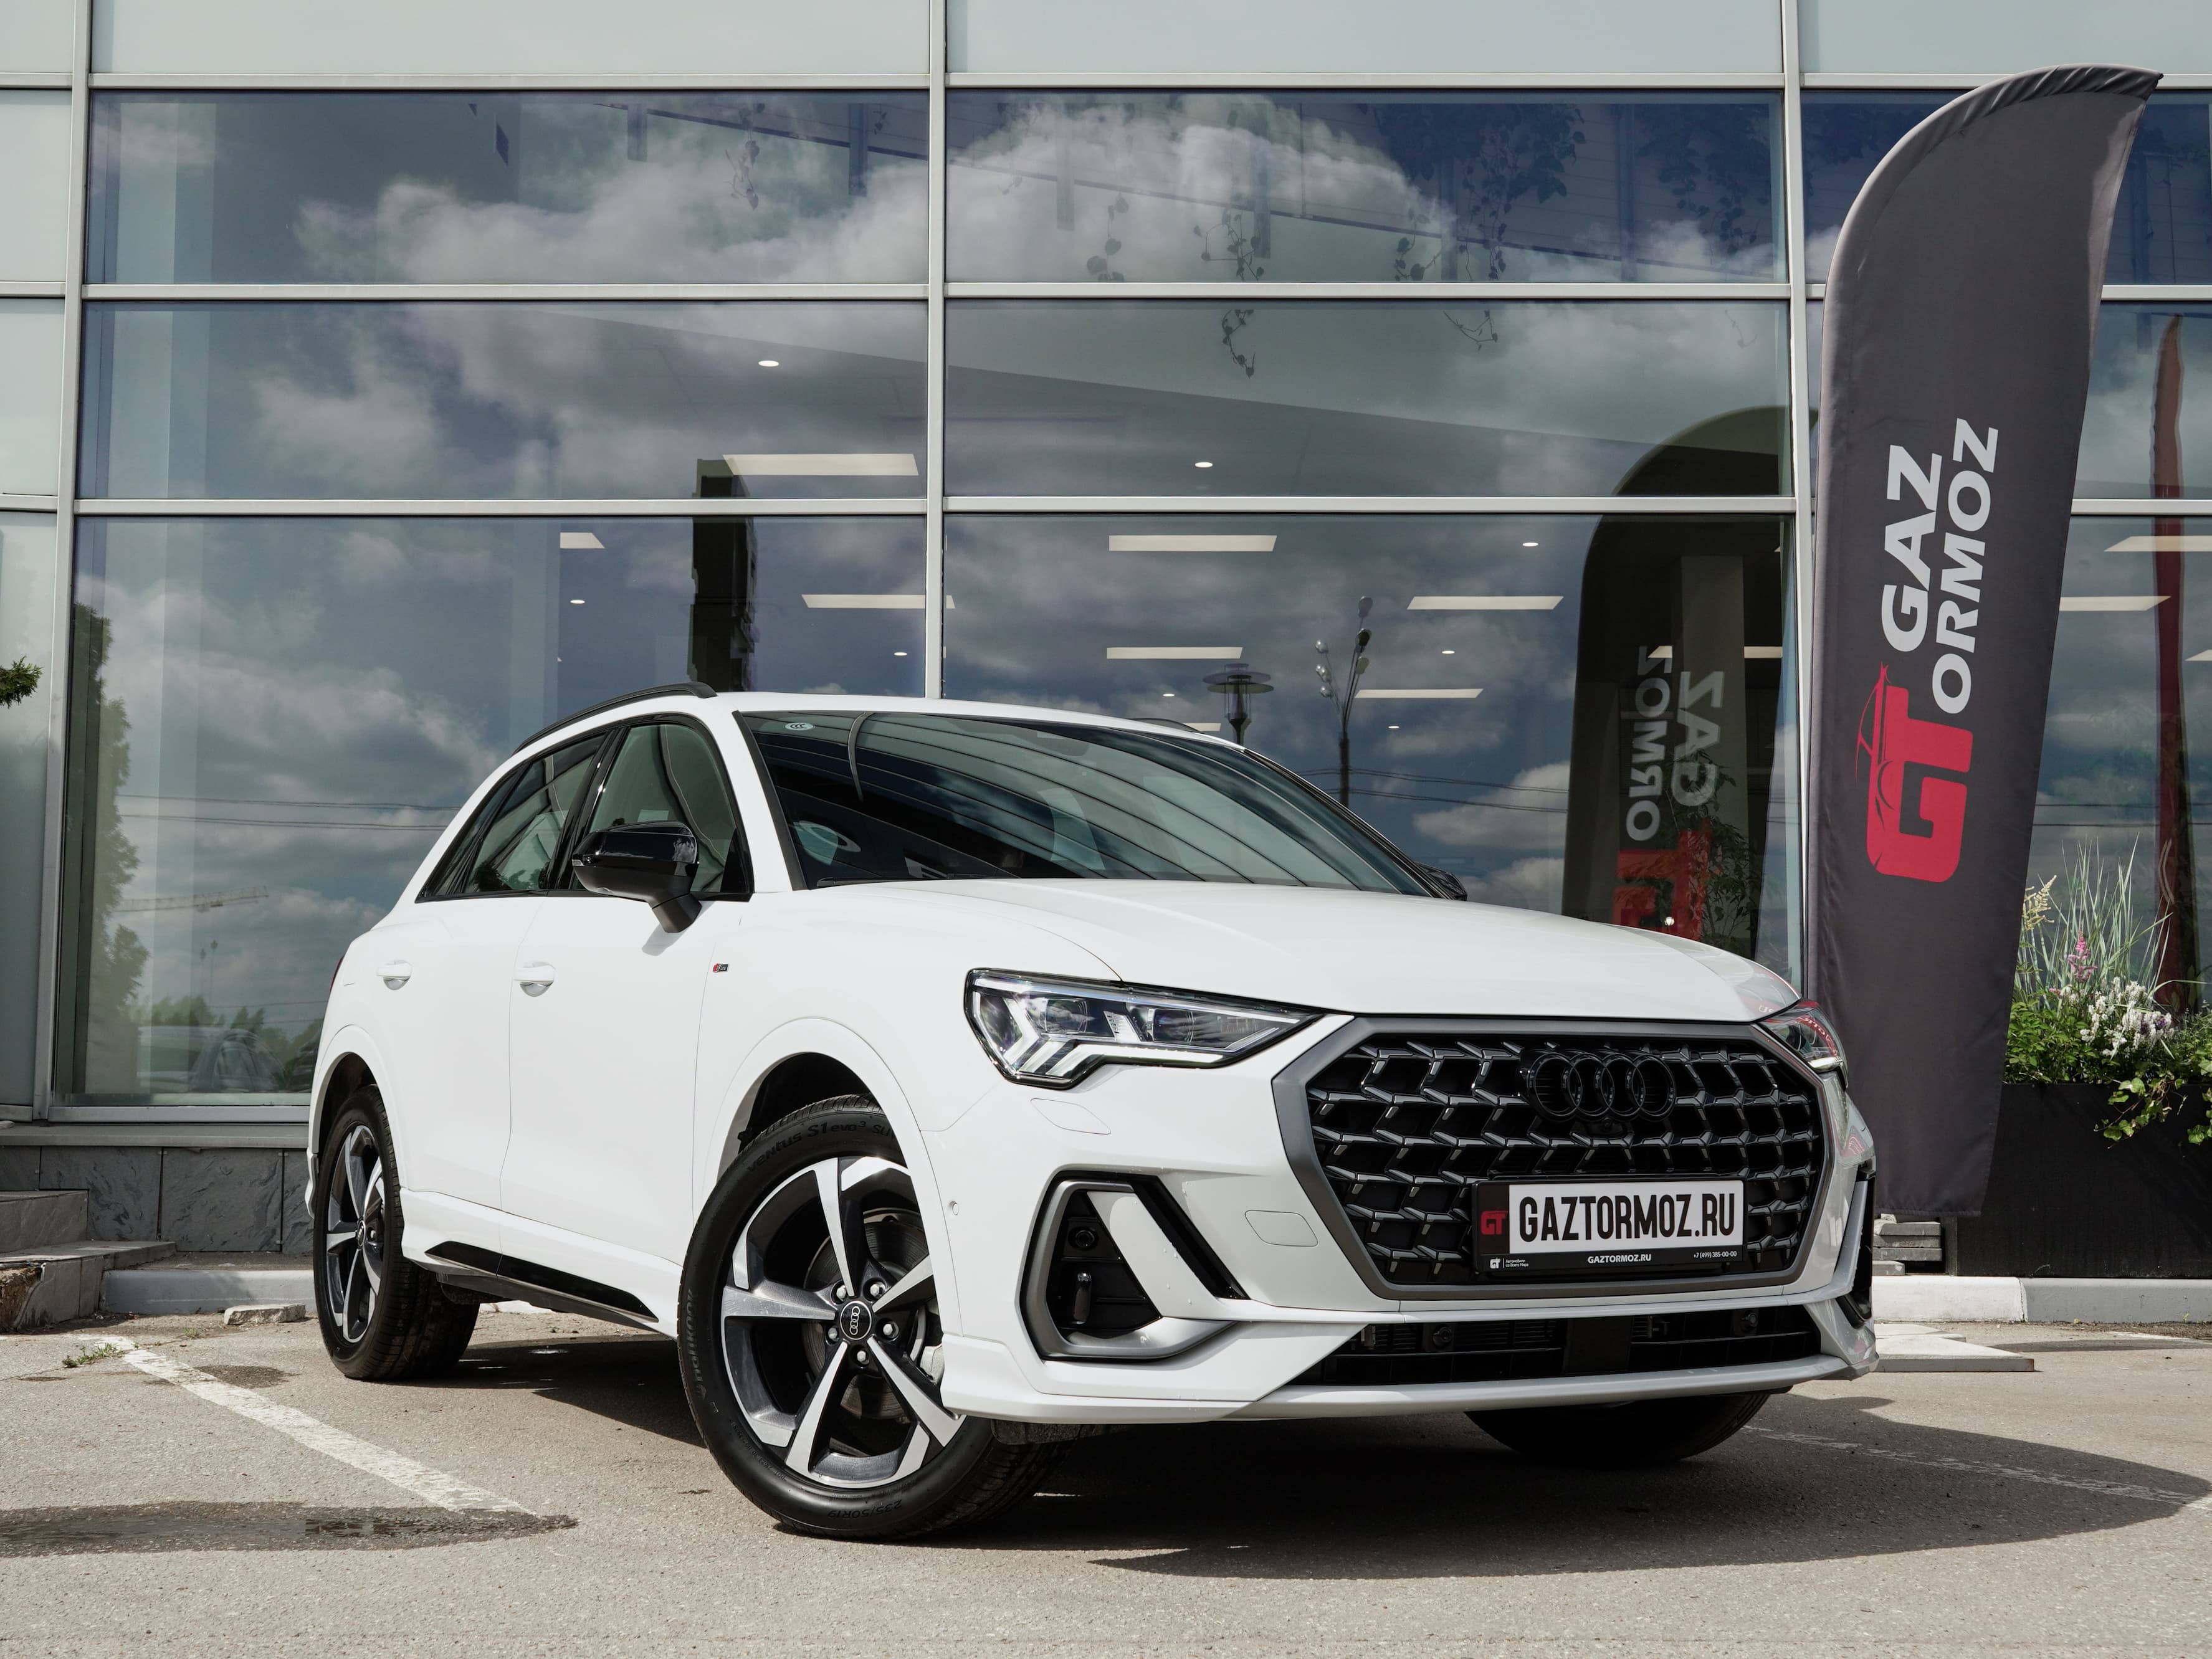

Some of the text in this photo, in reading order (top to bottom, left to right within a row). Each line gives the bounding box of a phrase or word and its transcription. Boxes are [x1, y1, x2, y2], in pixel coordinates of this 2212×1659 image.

[1881, 444, 1942, 652] GAZ
[1932, 417, 1998, 714] ORMOZ
[872, 1124, 896, 1139] SU
[1480, 1210, 1507, 1235] GT
[1518, 1192, 1735, 1243] GAZTORMOZ.RU
[1587, 1253, 1652, 1264] GAZTORMOZ.RU
[827, 1499, 903, 1519] 235/50R19
